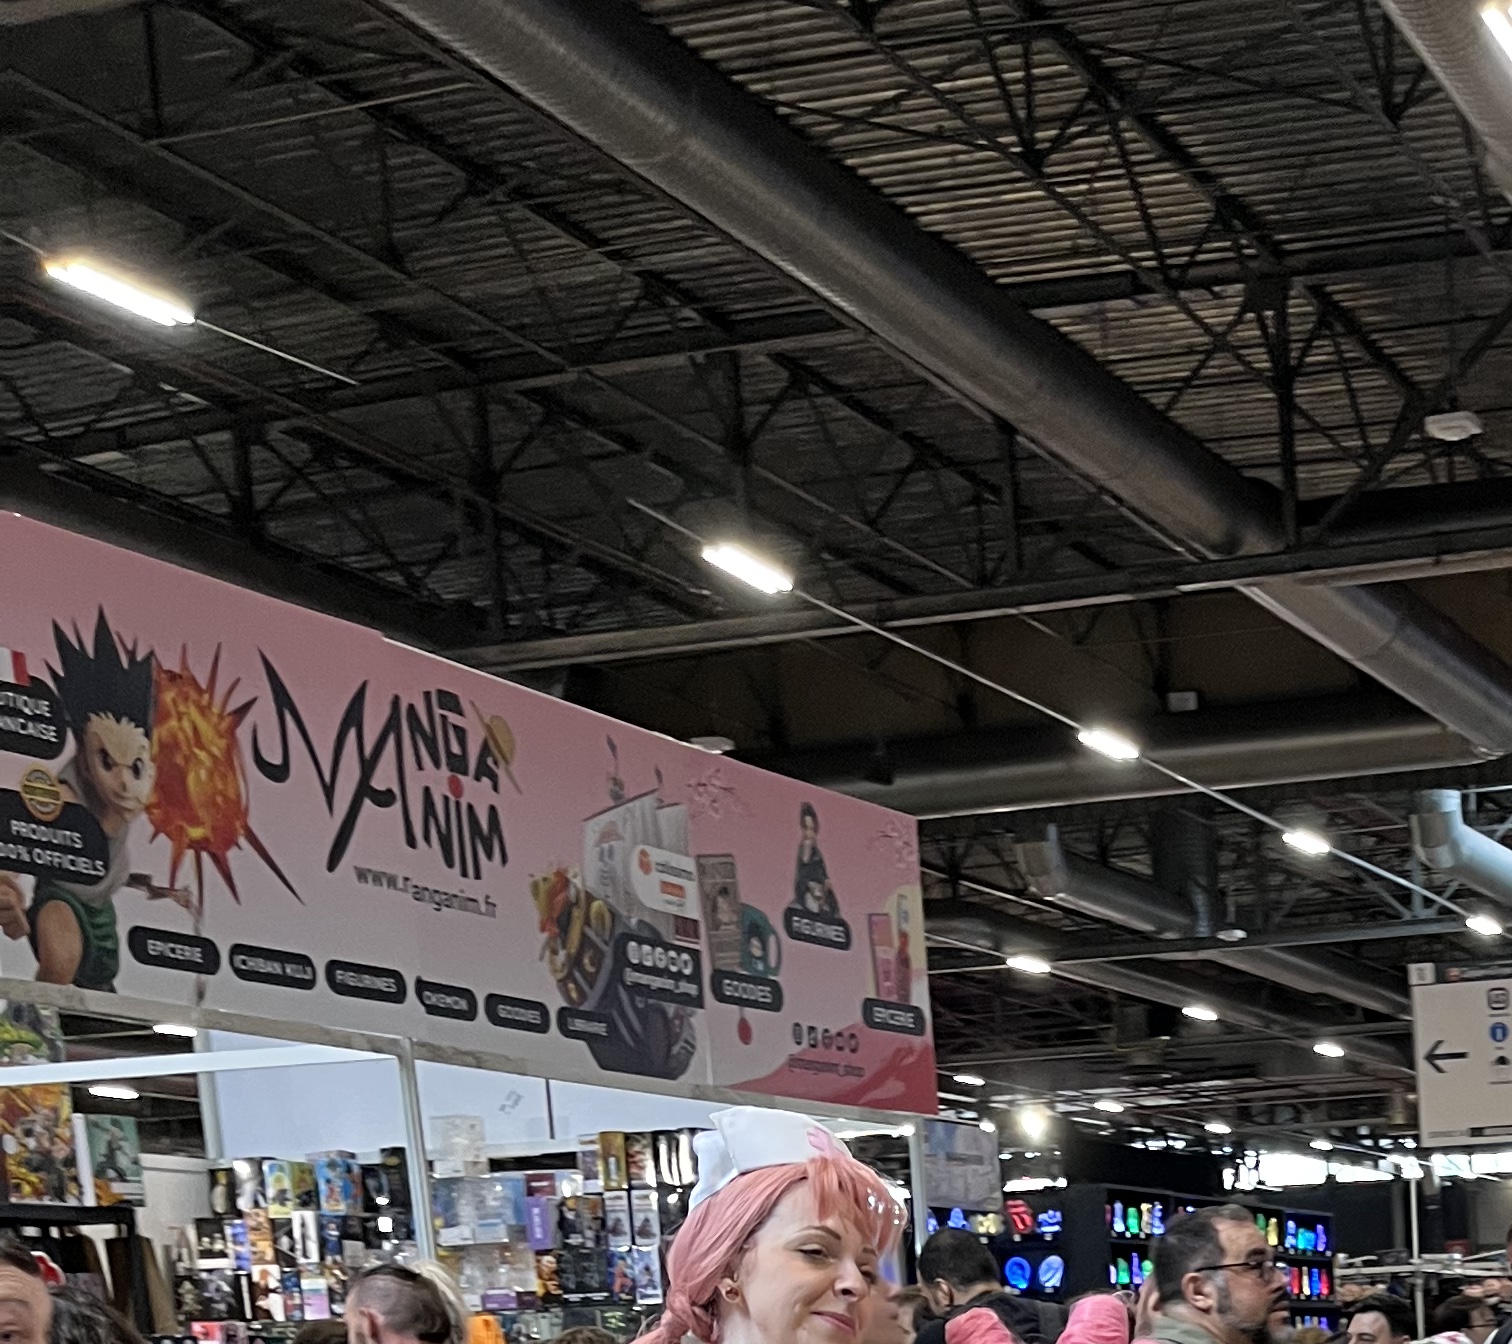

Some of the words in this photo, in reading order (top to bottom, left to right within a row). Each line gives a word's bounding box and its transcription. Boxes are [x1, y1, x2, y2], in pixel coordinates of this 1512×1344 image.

[10, 819, 83, 848] PRODUITS
[32, 848, 106, 877] OFFICIELS
[791, 915, 847, 942] FIGURINES
[146, 938, 204, 963] EPICERIE
[335, 969, 399, 994] FIGURINES
[722, 979, 773, 1004] GOODIES
[496, 1004, 542, 1024] GOODIES
